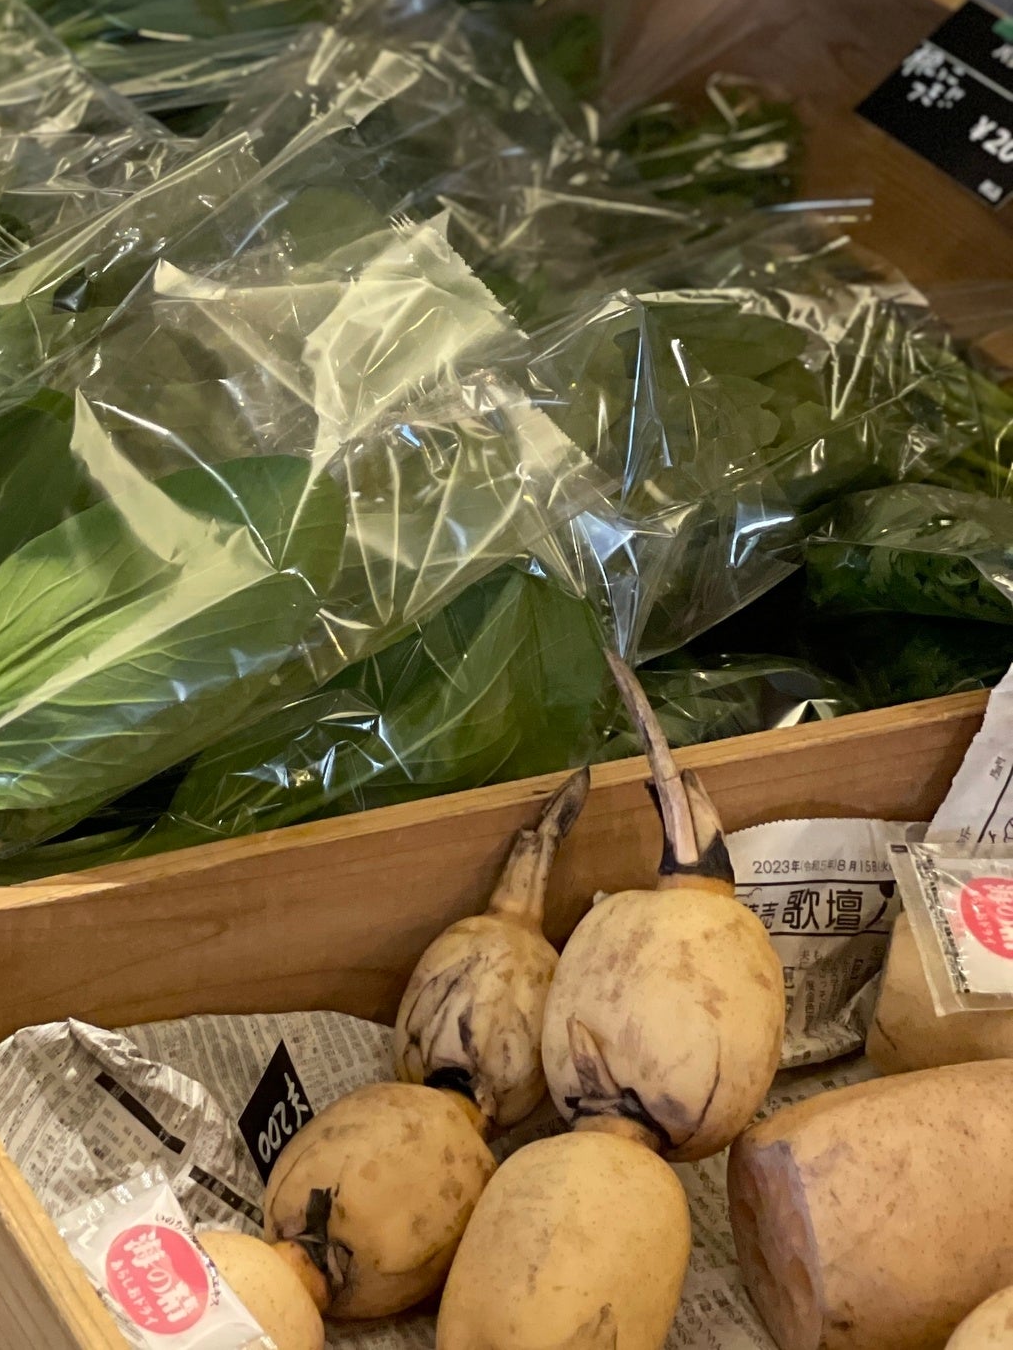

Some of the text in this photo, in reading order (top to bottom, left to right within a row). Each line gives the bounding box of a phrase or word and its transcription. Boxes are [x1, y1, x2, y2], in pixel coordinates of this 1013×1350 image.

[752, 859, 892, 875] 2023年(令和5年)8月15日(火
[257, 1071, 309, 1164] ¥200
[123, 1229, 200, 1323] 海の精
